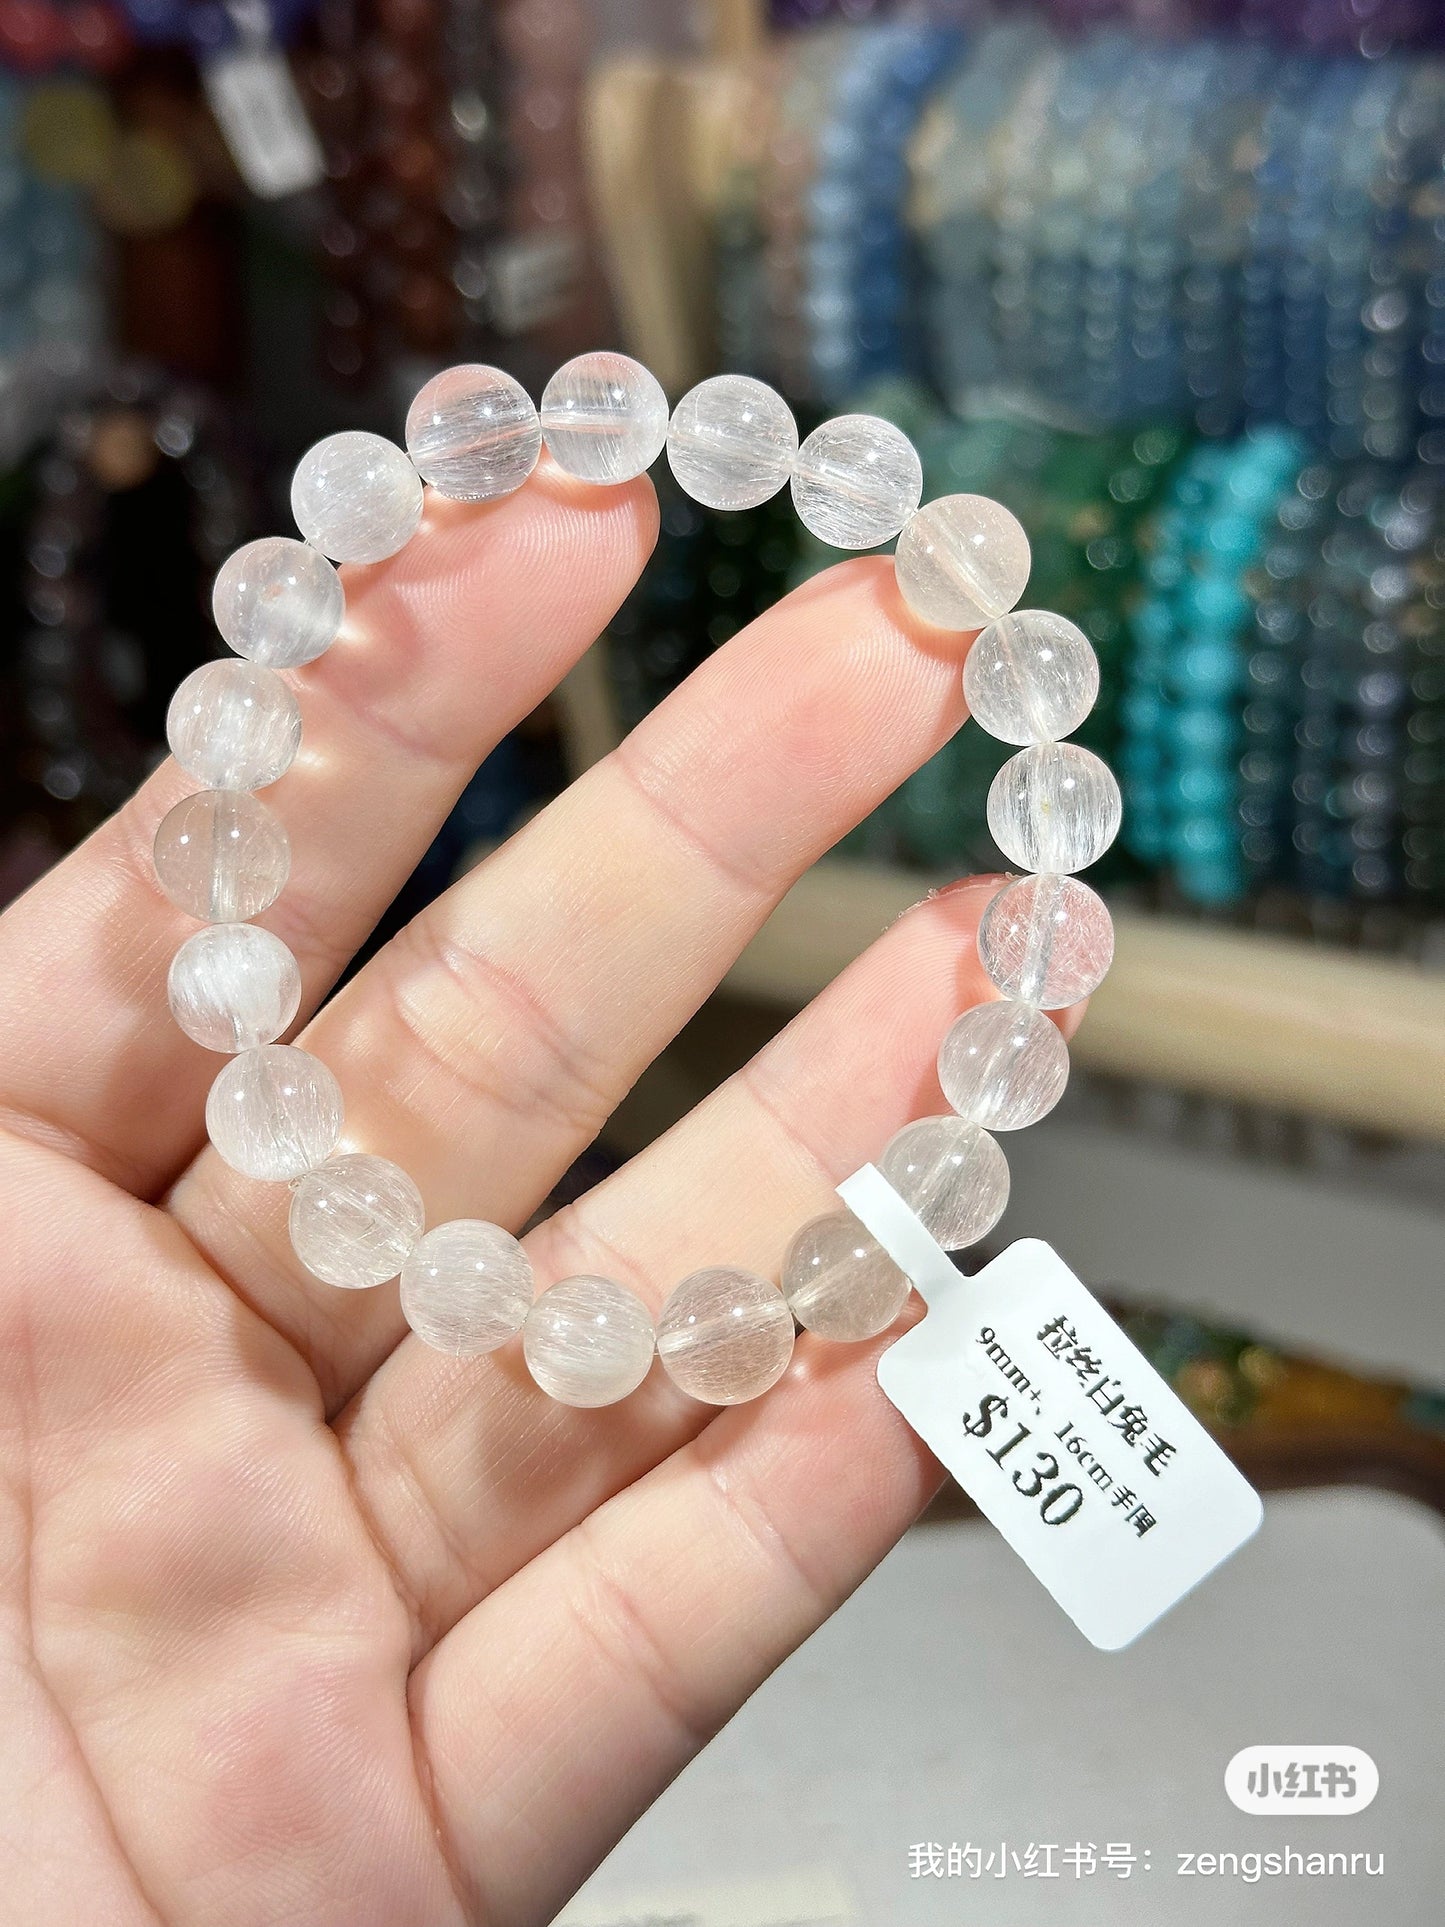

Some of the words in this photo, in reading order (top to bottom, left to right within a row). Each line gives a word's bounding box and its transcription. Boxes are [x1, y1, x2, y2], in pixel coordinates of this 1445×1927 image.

[963, 1394, 1084, 1526] $130
[1037, 1315, 1177, 1477] 拉丝白兔毛
